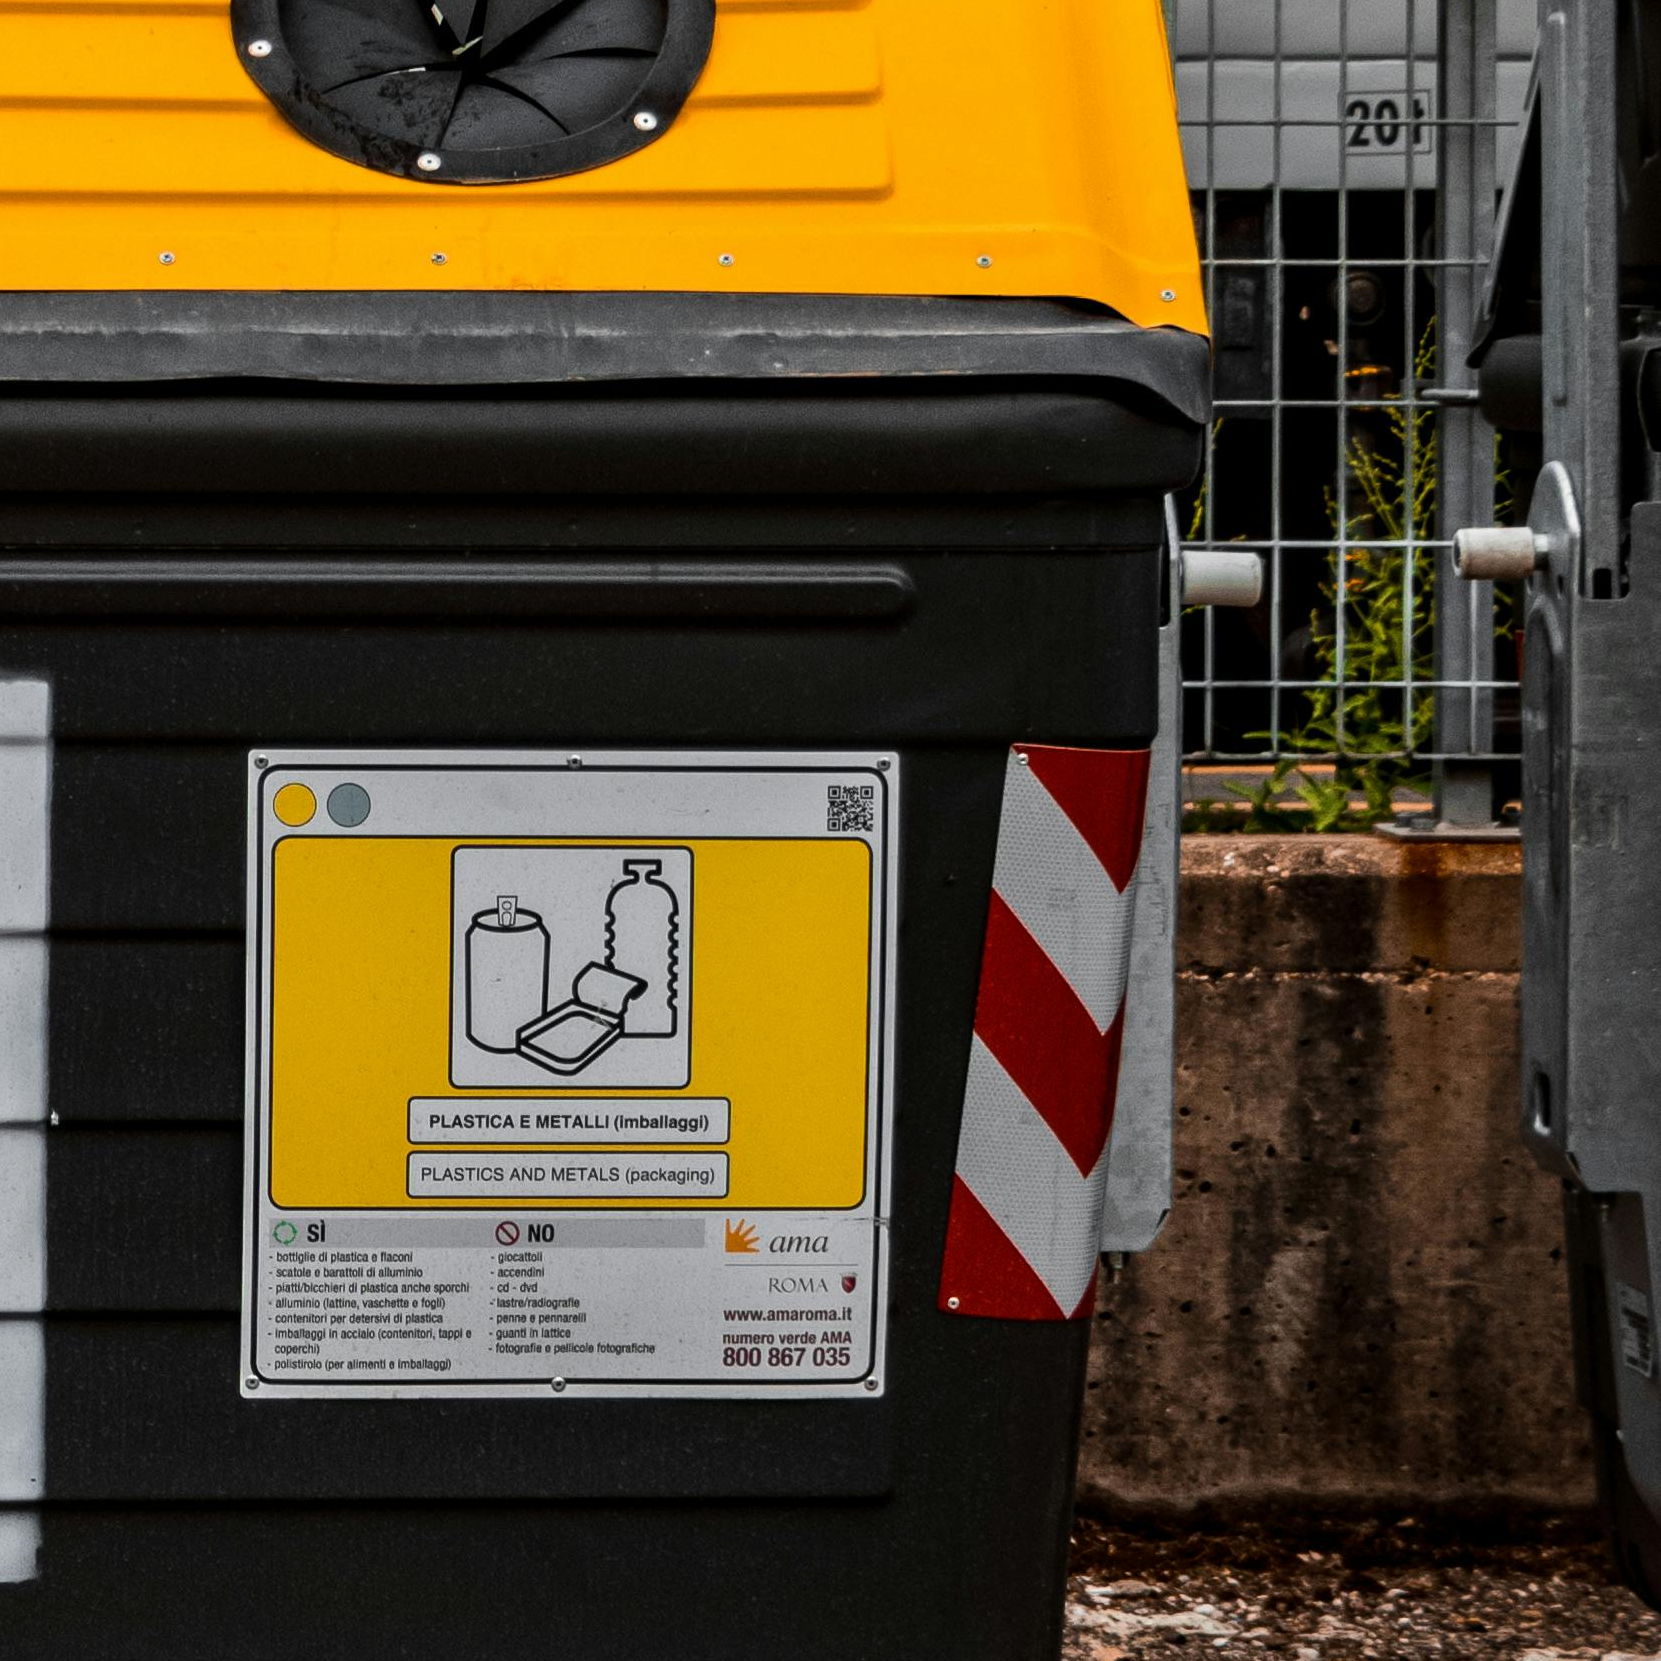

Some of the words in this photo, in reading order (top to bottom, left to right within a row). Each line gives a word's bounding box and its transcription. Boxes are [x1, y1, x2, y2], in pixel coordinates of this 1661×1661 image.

[430, 1115, 514, 1129] PLASTICA
[520, 1116, 530, 1129] E
[536, 1116, 608, 1129] METALLI
[614, 1116, 709, 1132] (imballaggi)
[421, 1168, 504, 1181] PLASTICS
[510, 1168, 545, 1181] AND
[551, 1168, 619, 1181] METALS
[625, 1168, 715, 1184] (packaging)
[528, 1224, 554, 1242] NO
[770, 1236, 828, 1253] ama
[277, 1252, 315, 1264] bottiglie
[319, 1252, 327, 1262] di
[331, 1252, 368, 1264] plastica
[372, 1254, 377, 1262] e
[381, 1252, 413, 1262] flaconi
[498, 1252, 542, 1264] giocattoli
[276, 1268, 311, 1278] scatole
[315, 1269, 320, 1277] e
[324, 1268, 363, 1278] barattoli
[367, 1268, 375, 1278] di
[379, 1268, 423, 1278] alluminio
[498, 1268, 544, 1278] accendini
[276, 1283, 345, 1294] piatti/bicchieri
[349, 1283, 357, 1293] di
[361, 1283, 398, 1294] plastica
[401, 1283, 431, 1293] anche
[434, 1283, 469, 1294] sporchi
[497, 1283, 509, 1292] cd
[520, 1283, 537, 1292] dvd
[769, 1278, 828, 1293] ROMA
[497, 1298, 580, 1309] lastre/radiografie
[275, 1313, 327, 1324] contenitori
[330, 1315, 346, 1325] per
[350, 1313, 390, 1324] detersivi
[393, 1313, 402, 1324] di
[406, 1313, 443, 1325] plastica
[497, 1314, 526, 1324] penne
[530, 1315, 535, 1323] e
[539, 1313, 586, 1324] pennarelli
[724, 1307, 852, 1321] www.amaroma.it
[496, 1328, 527, 1340] guanti
[530, 1329, 538, 1338] in
[542, 1328, 571, 1338] lattice
[723, 1333, 774, 1344] numero
[779, 1332, 816, 1344] verde
[821, 1332, 852, 1344] AMA
[275, 1344, 319, 1356] coperchi)
[496, 1344, 542, 1355] fotografie
[545, 1345, 551, 1353] e
[554, 1344, 594, 1355] pellicole
[597, 1344, 655, 1355] fotografiche
[723, 1348, 761, 1366] 800
[768, 1348, 806, 1366] 867
[813, 1348, 850, 1366] 035
